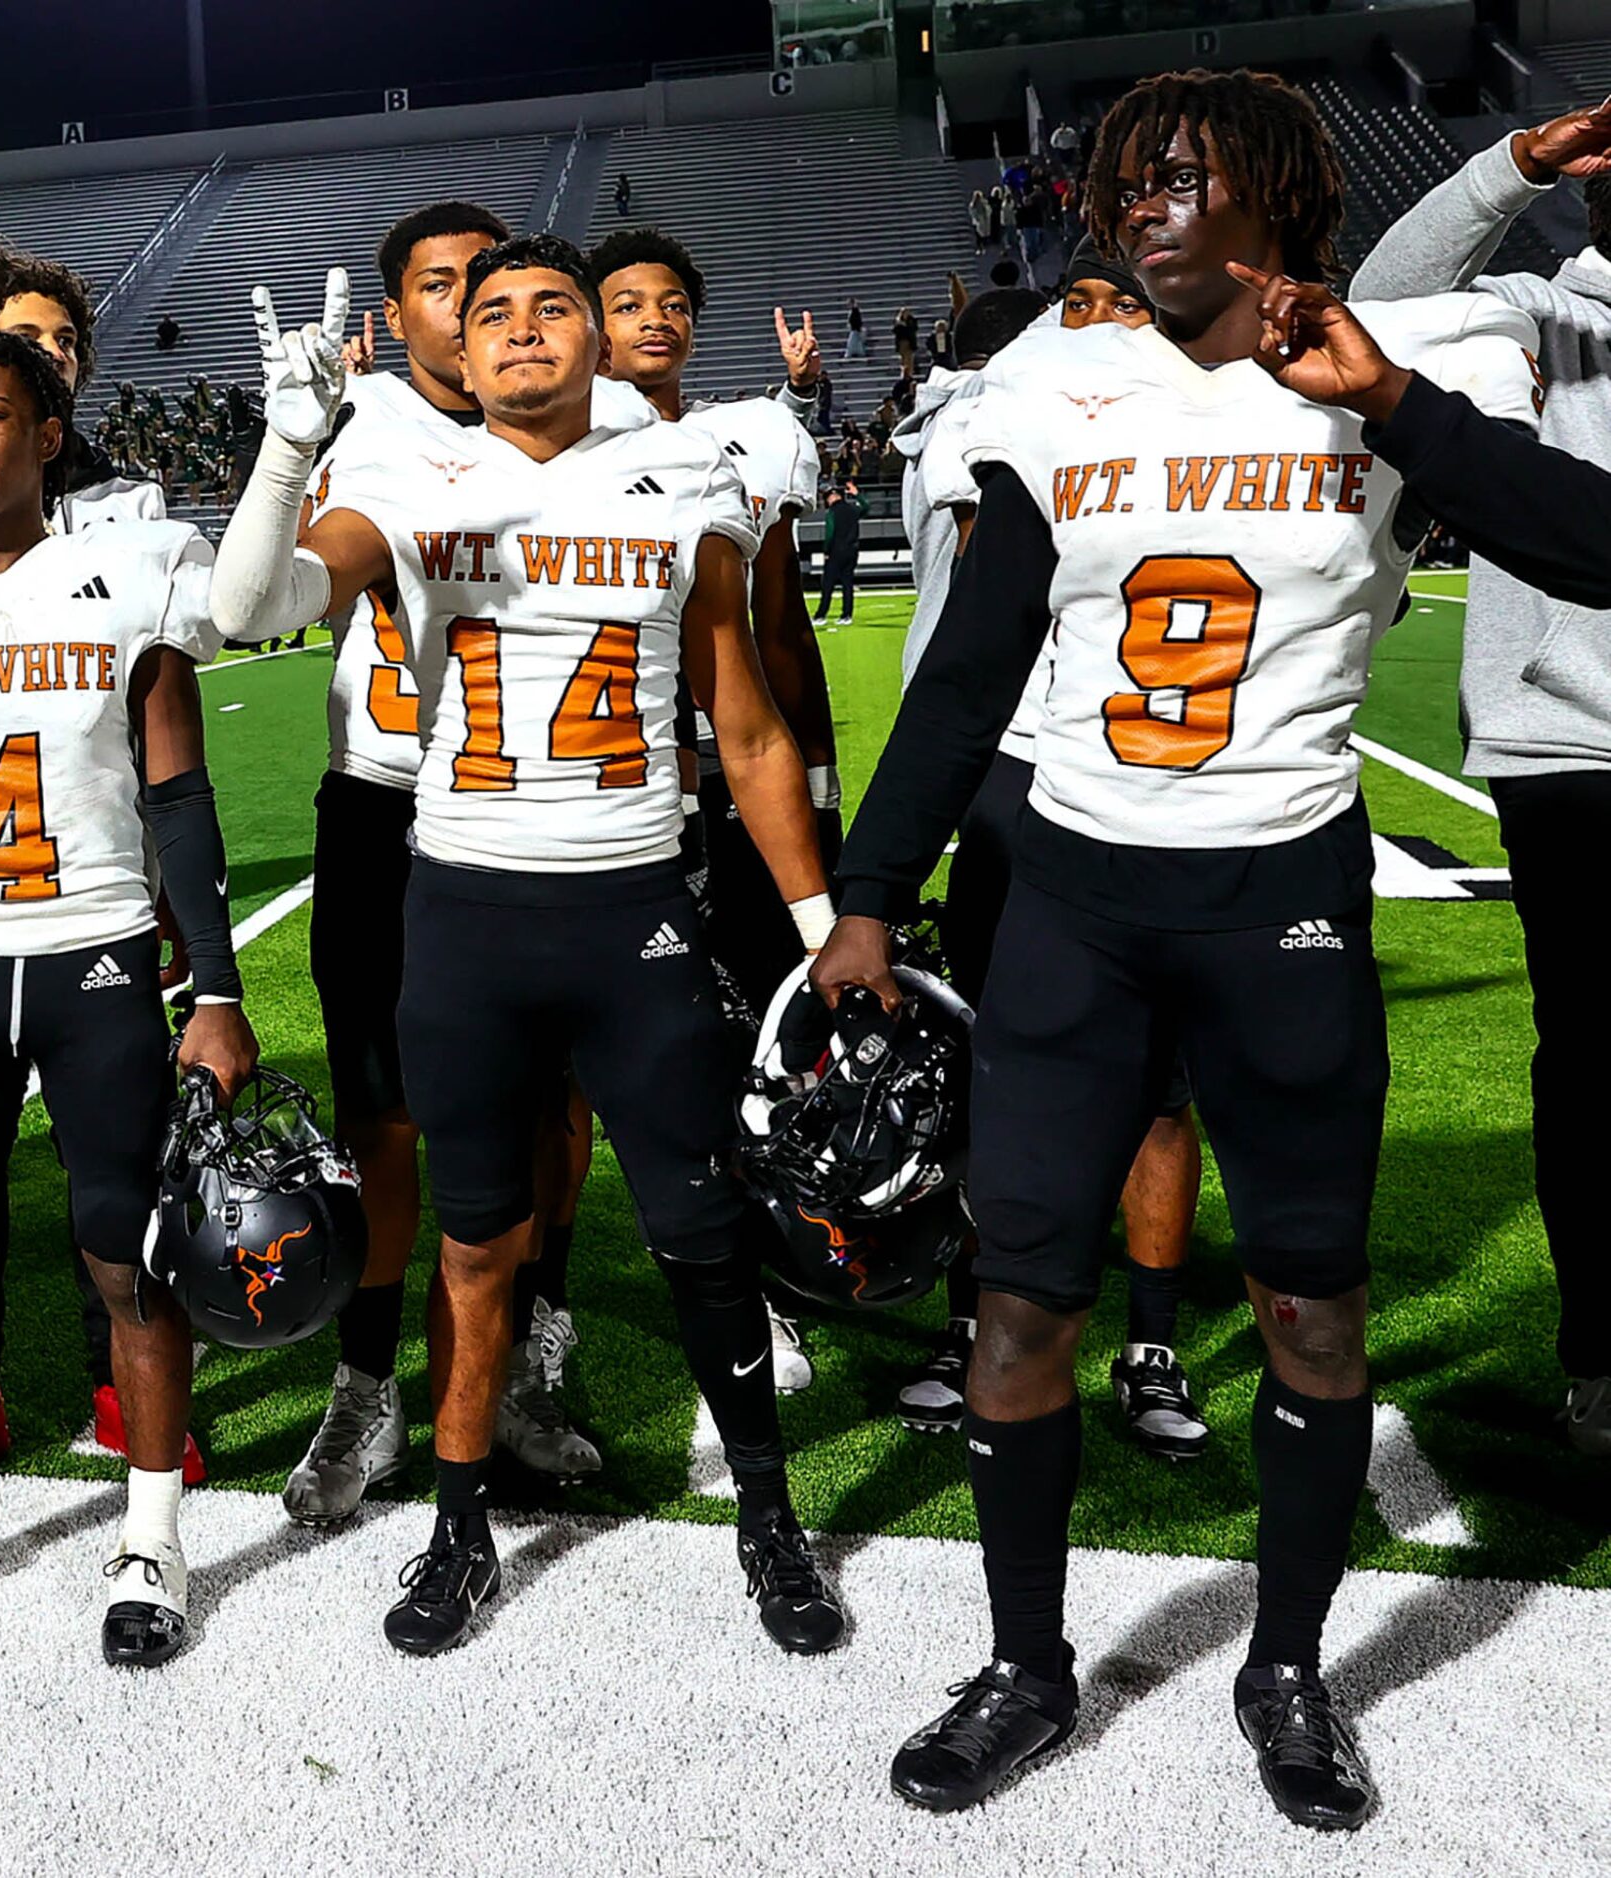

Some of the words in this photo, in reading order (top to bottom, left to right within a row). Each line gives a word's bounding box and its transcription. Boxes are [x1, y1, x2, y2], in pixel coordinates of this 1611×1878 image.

[772, 72, 792, 95] C
[387, 90, 406, 111] B
[64, 124, 83, 144] A
[1053, 457, 1136, 523] W.T.
[1164, 453, 1373, 514] WHITE
[413, 531, 501, 582] W.T.
[517, 533, 678, 590] WHITE
[1101, 553, 1263, 773] 9
[445, 615, 650, 793] 14
[640, 942, 690, 960] adidas
[1279, 931, 1344, 950] adidas
[80, 973, 132, 990] adidas
